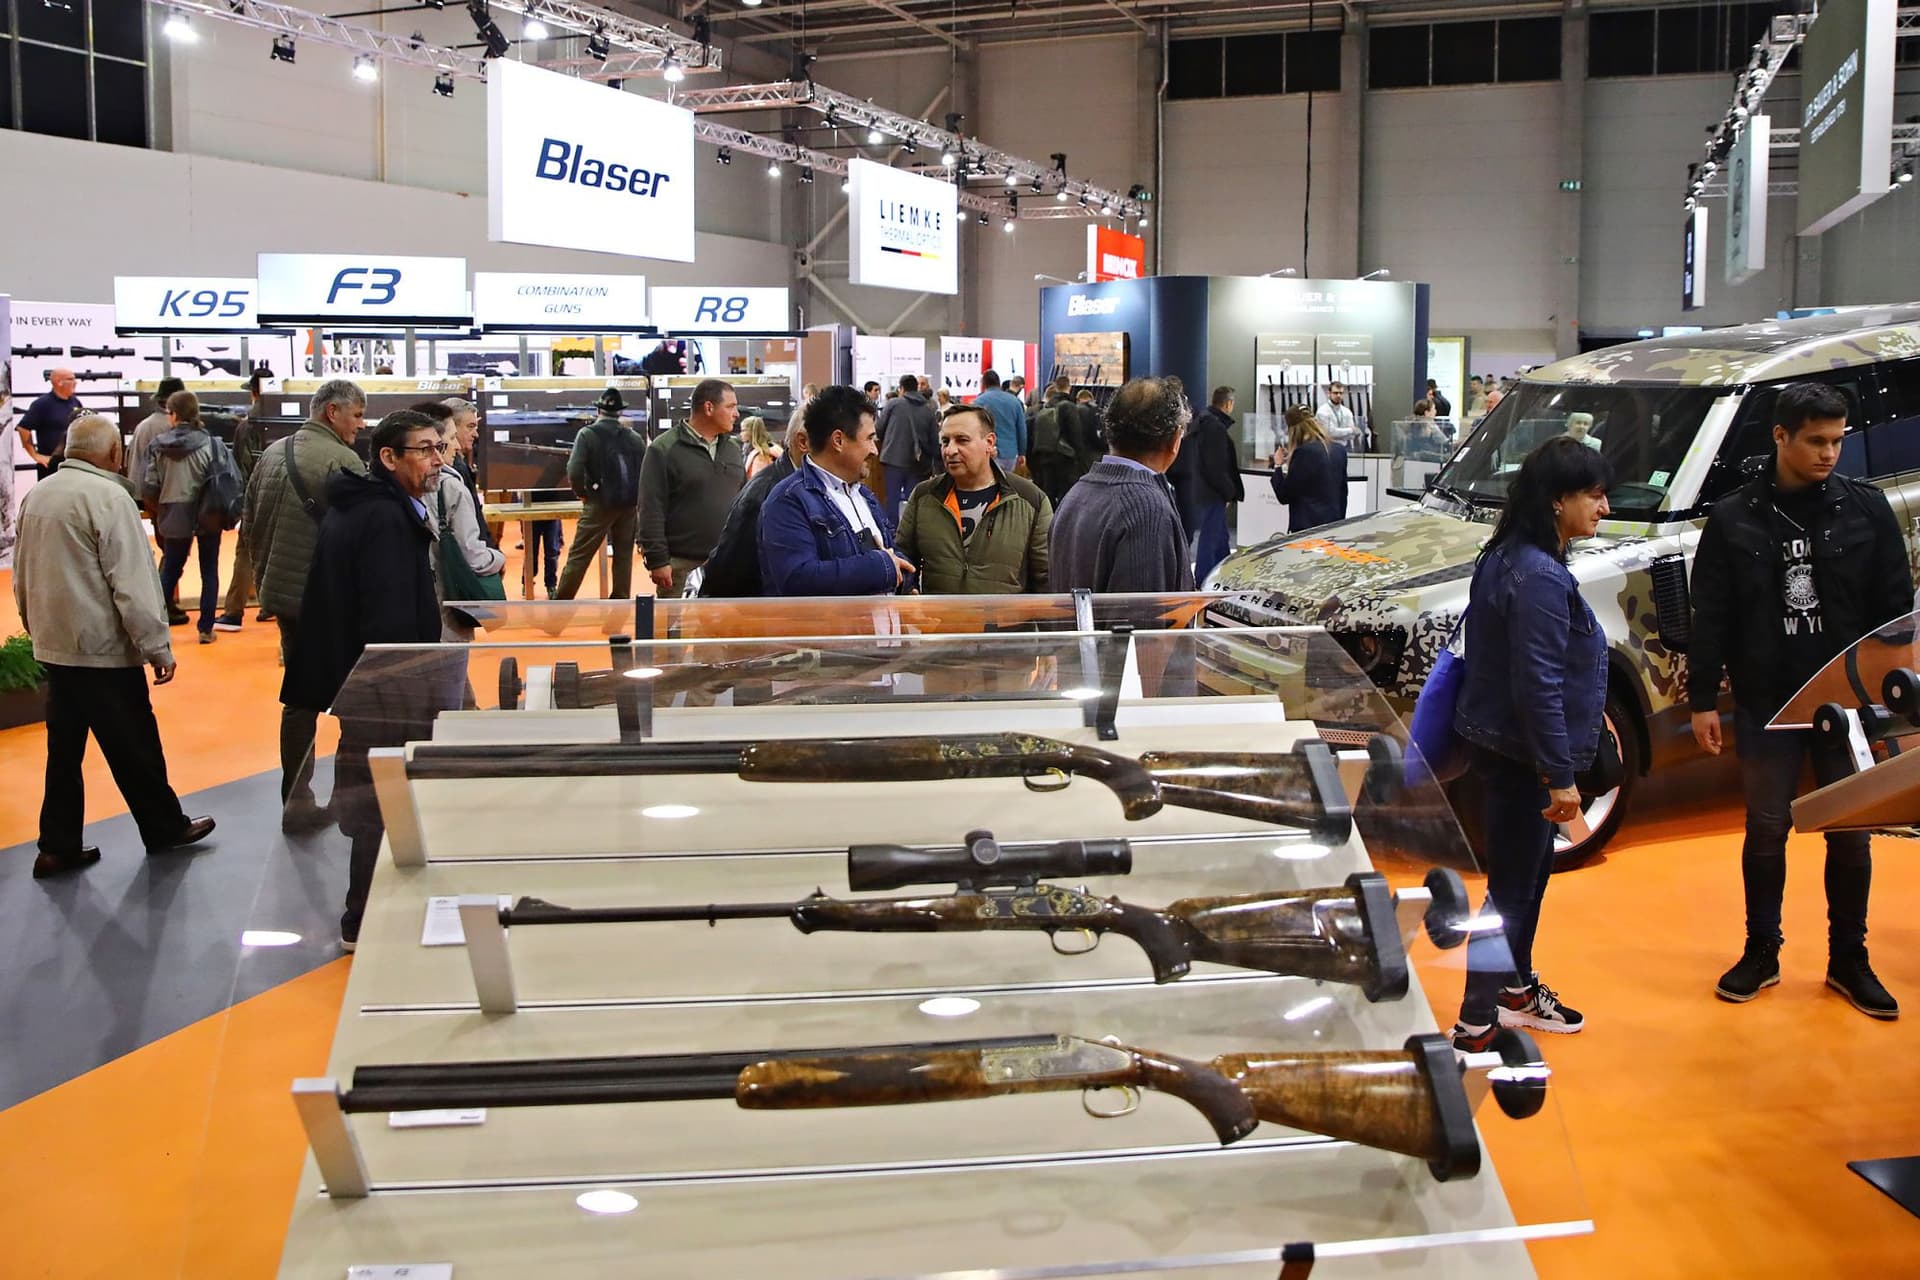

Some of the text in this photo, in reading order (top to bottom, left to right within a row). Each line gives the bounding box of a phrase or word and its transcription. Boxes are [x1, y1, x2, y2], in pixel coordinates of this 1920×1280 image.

[536, 137, 670, 198] Blaser
[880, 199, 941, 231] LIEMKE
[326, 268, 402, 305] F3
[517, 285, 609, 297] COMBINATION
[158, 289, 250, 317] K95
[544, 303, 582, 314] GUNS
[694, 296, 749, 323] R8
[1067, 295, 1121, 317] Blaser
[16, 316, 28, 326] IN
[31, 316, 64, 327] EVERY
[67, 317, 92, 327] WAY
[416, 379, 465, 393] Blaser
[606, 378, 644, 388] Blaser
[757, 375, 788, 384] Blaser
